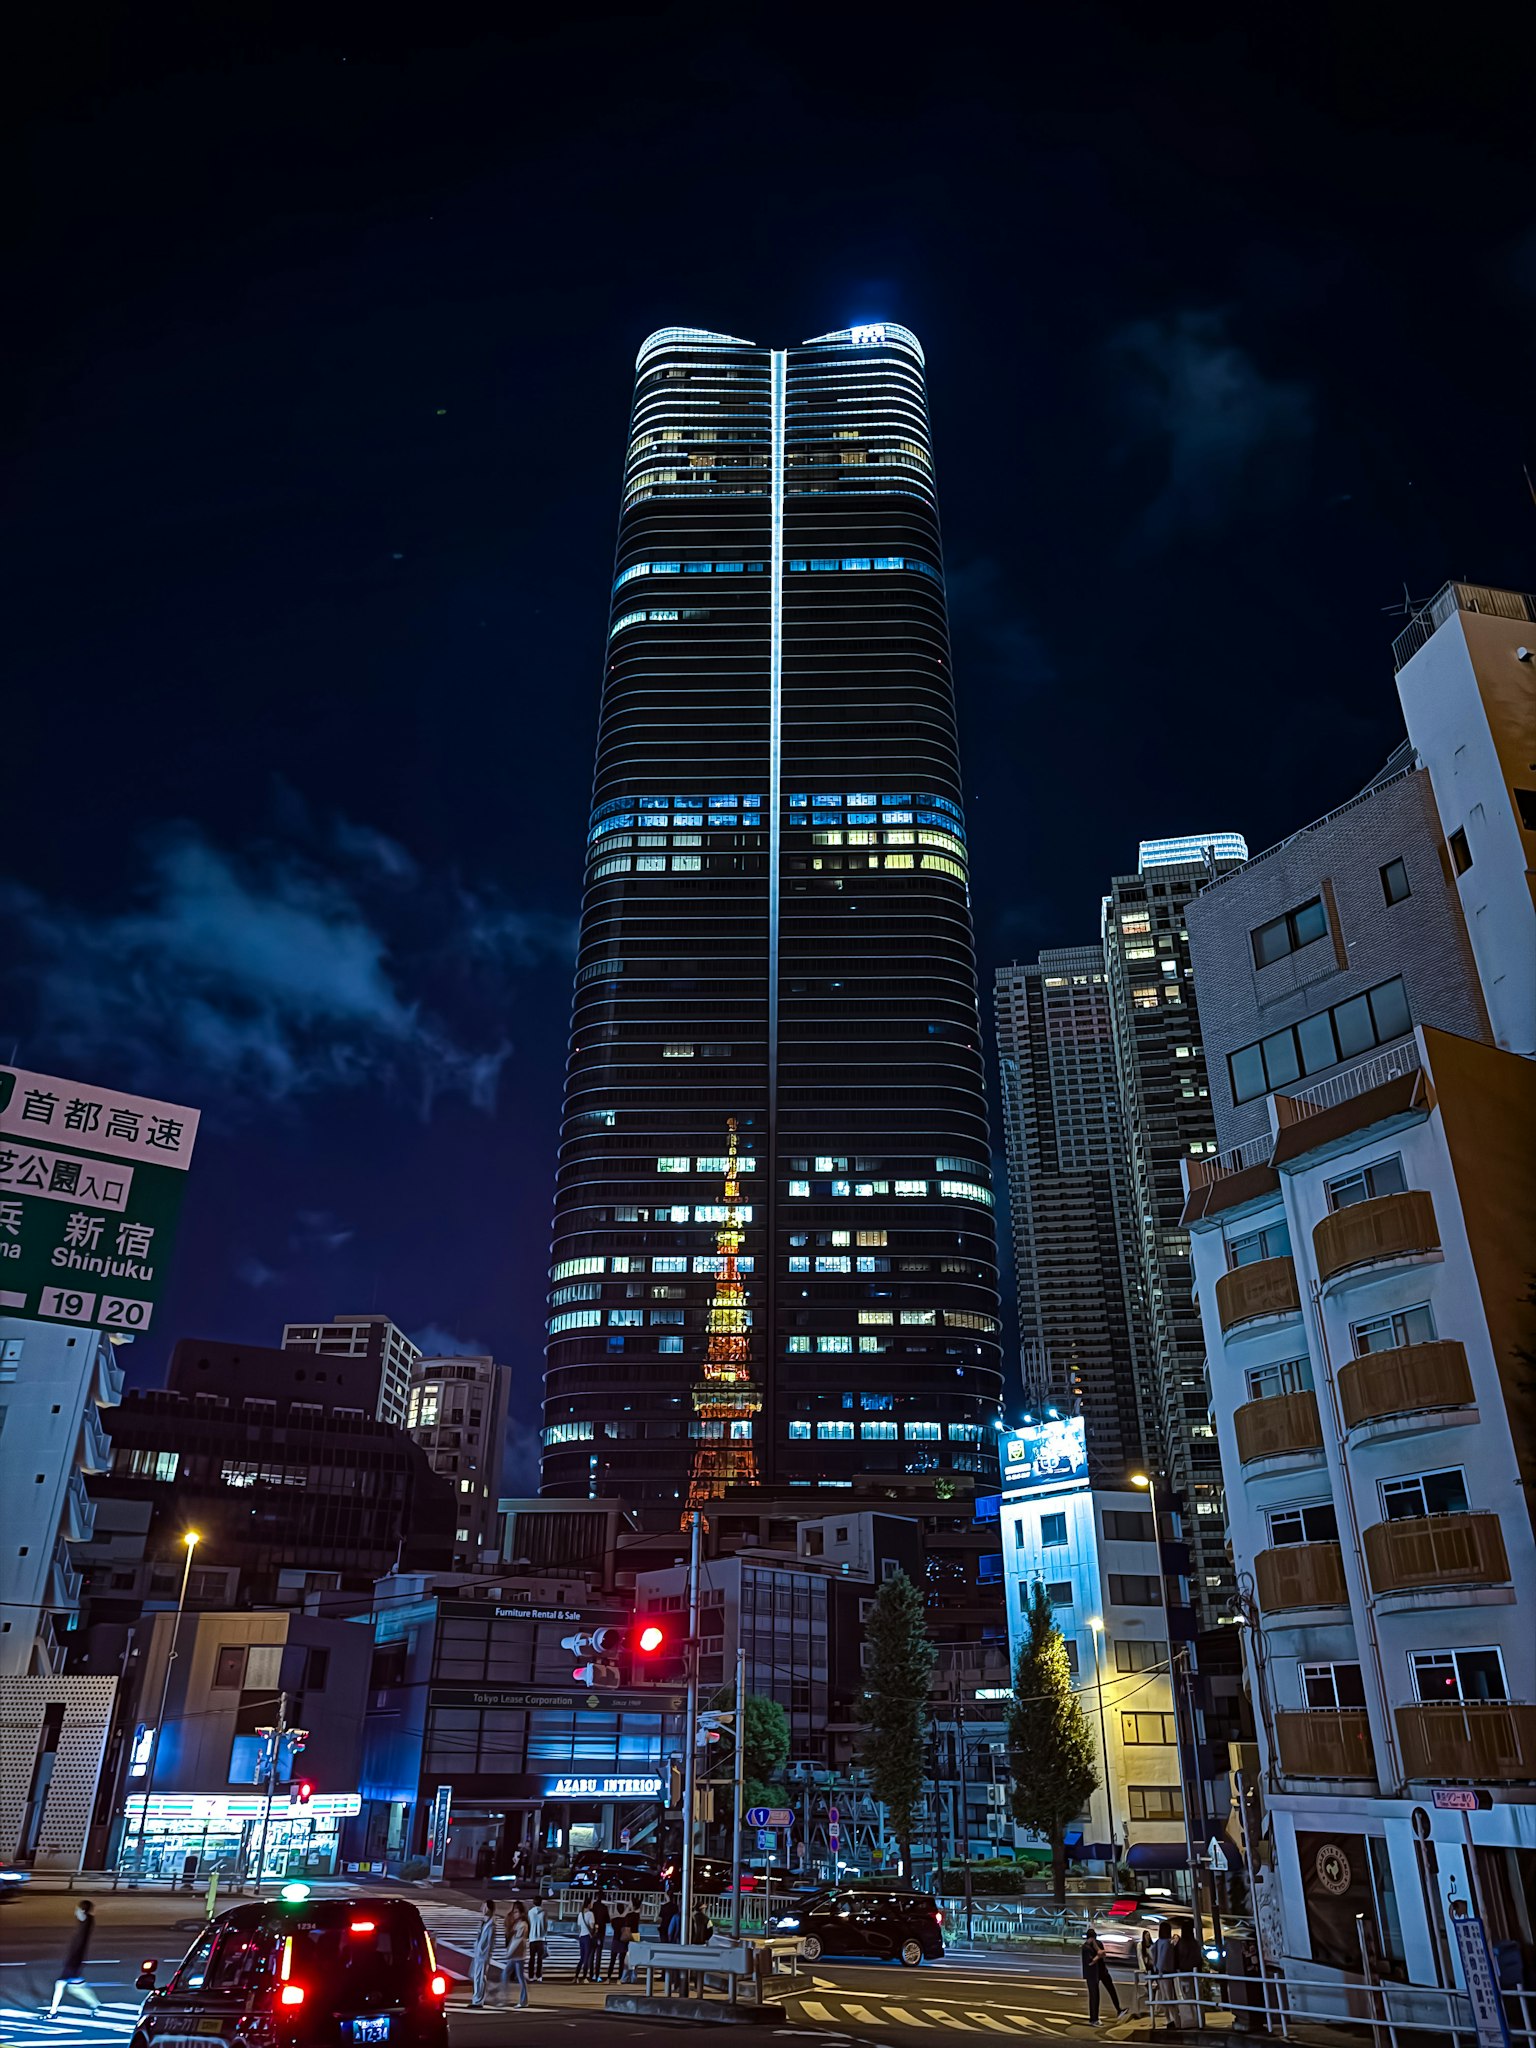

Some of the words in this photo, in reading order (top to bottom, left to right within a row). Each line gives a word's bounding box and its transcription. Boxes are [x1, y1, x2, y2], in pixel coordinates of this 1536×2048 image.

[21, 1089, 184, 1151] 首都高速
[63, 1211, 154, 1259] 新宿
[51, 1247, 154, 1281] Shinjuku
[52, 1292, 84, 1316] 19
[105, 1301, 145, 1325] 20
[495, 1607, 531, 1618] Furniture
[532, 1609, 557, 1619] Rental
[557, 1611, 564, 1620] &
[565, 1611, 581, 1621] Sale
[474, 1694, 499, 1703] Tokyo
[500, 1695, 524, 1704] Lease
[525, 1695, 573, 1706] Corporation
[555, 1779, 597, 1792] AZABU
[758, 1810, 764, 1822] 1
[362, 2027, 388, 2042] 12-34
